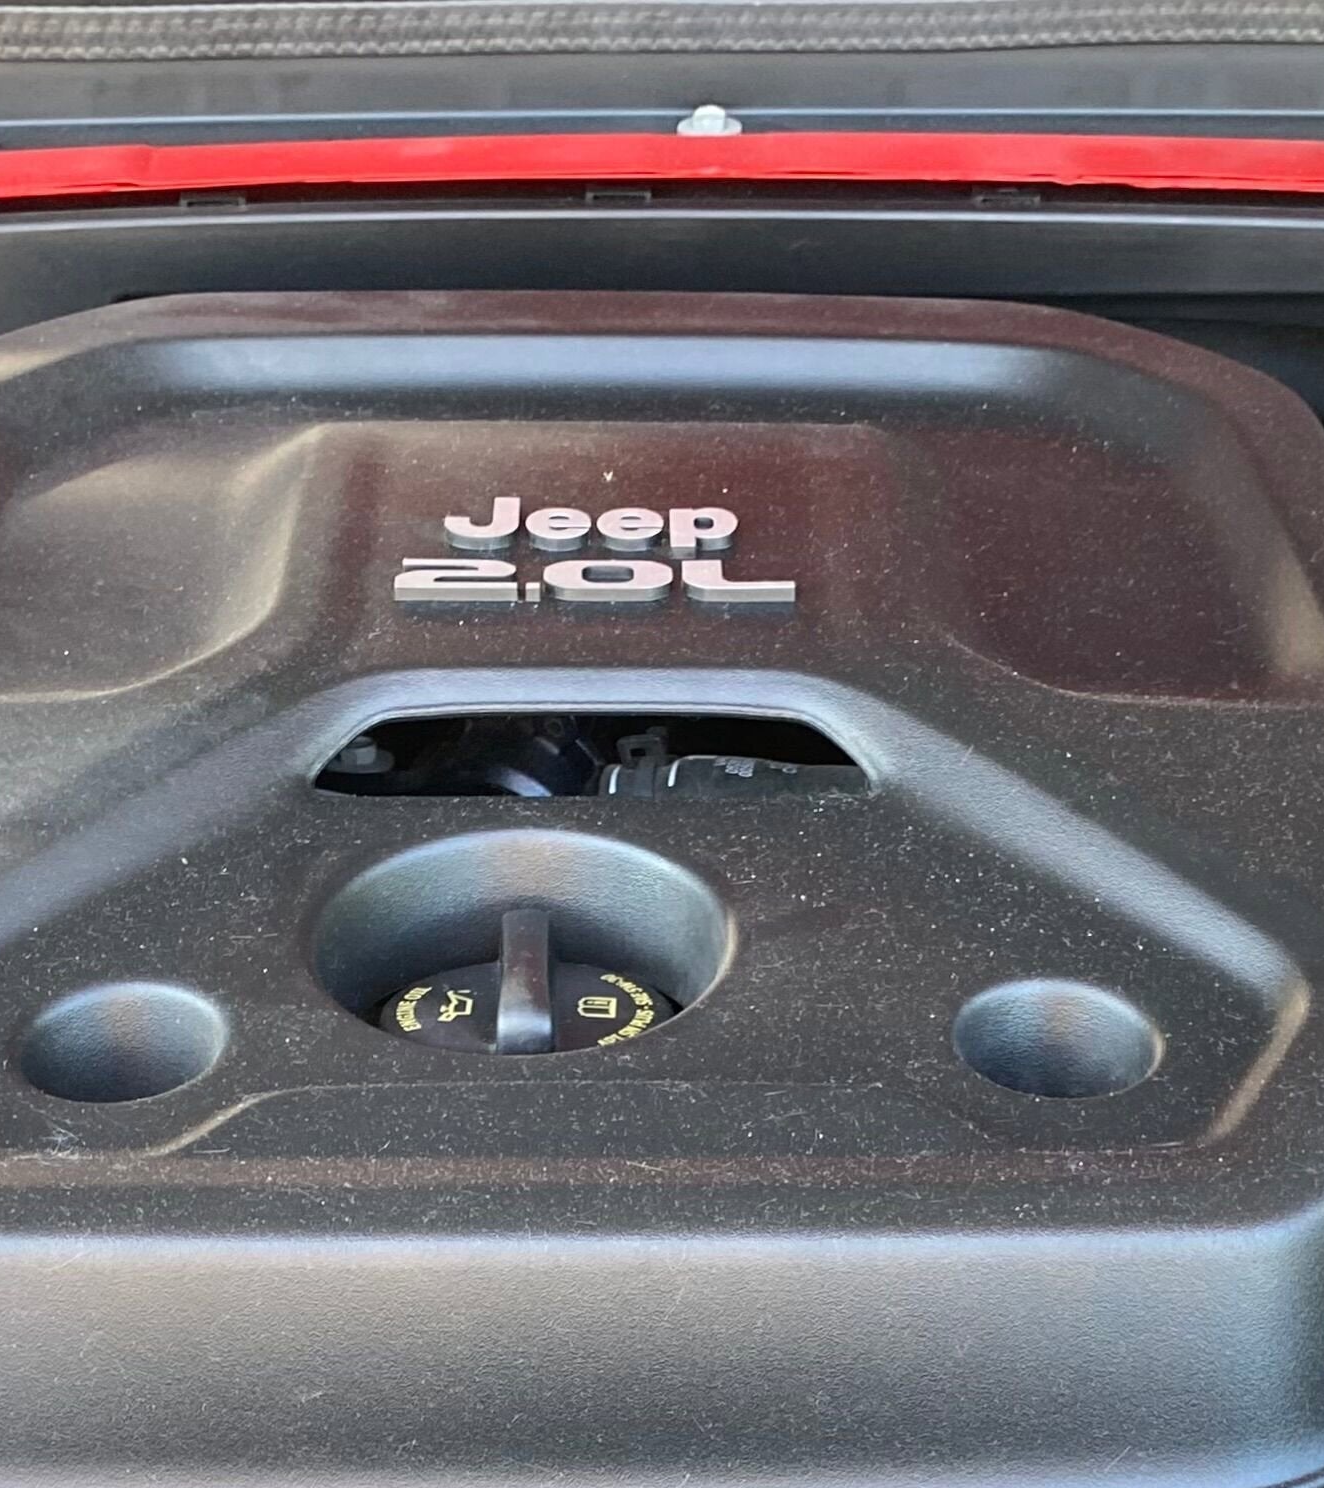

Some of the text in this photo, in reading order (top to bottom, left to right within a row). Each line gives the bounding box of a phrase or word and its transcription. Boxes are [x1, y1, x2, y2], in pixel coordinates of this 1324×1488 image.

[444, 497, 738, 558] Jeep
[394, 558, 796, 601] 2.0L
[396, 986, 433, 1032] ENGINE OIL
